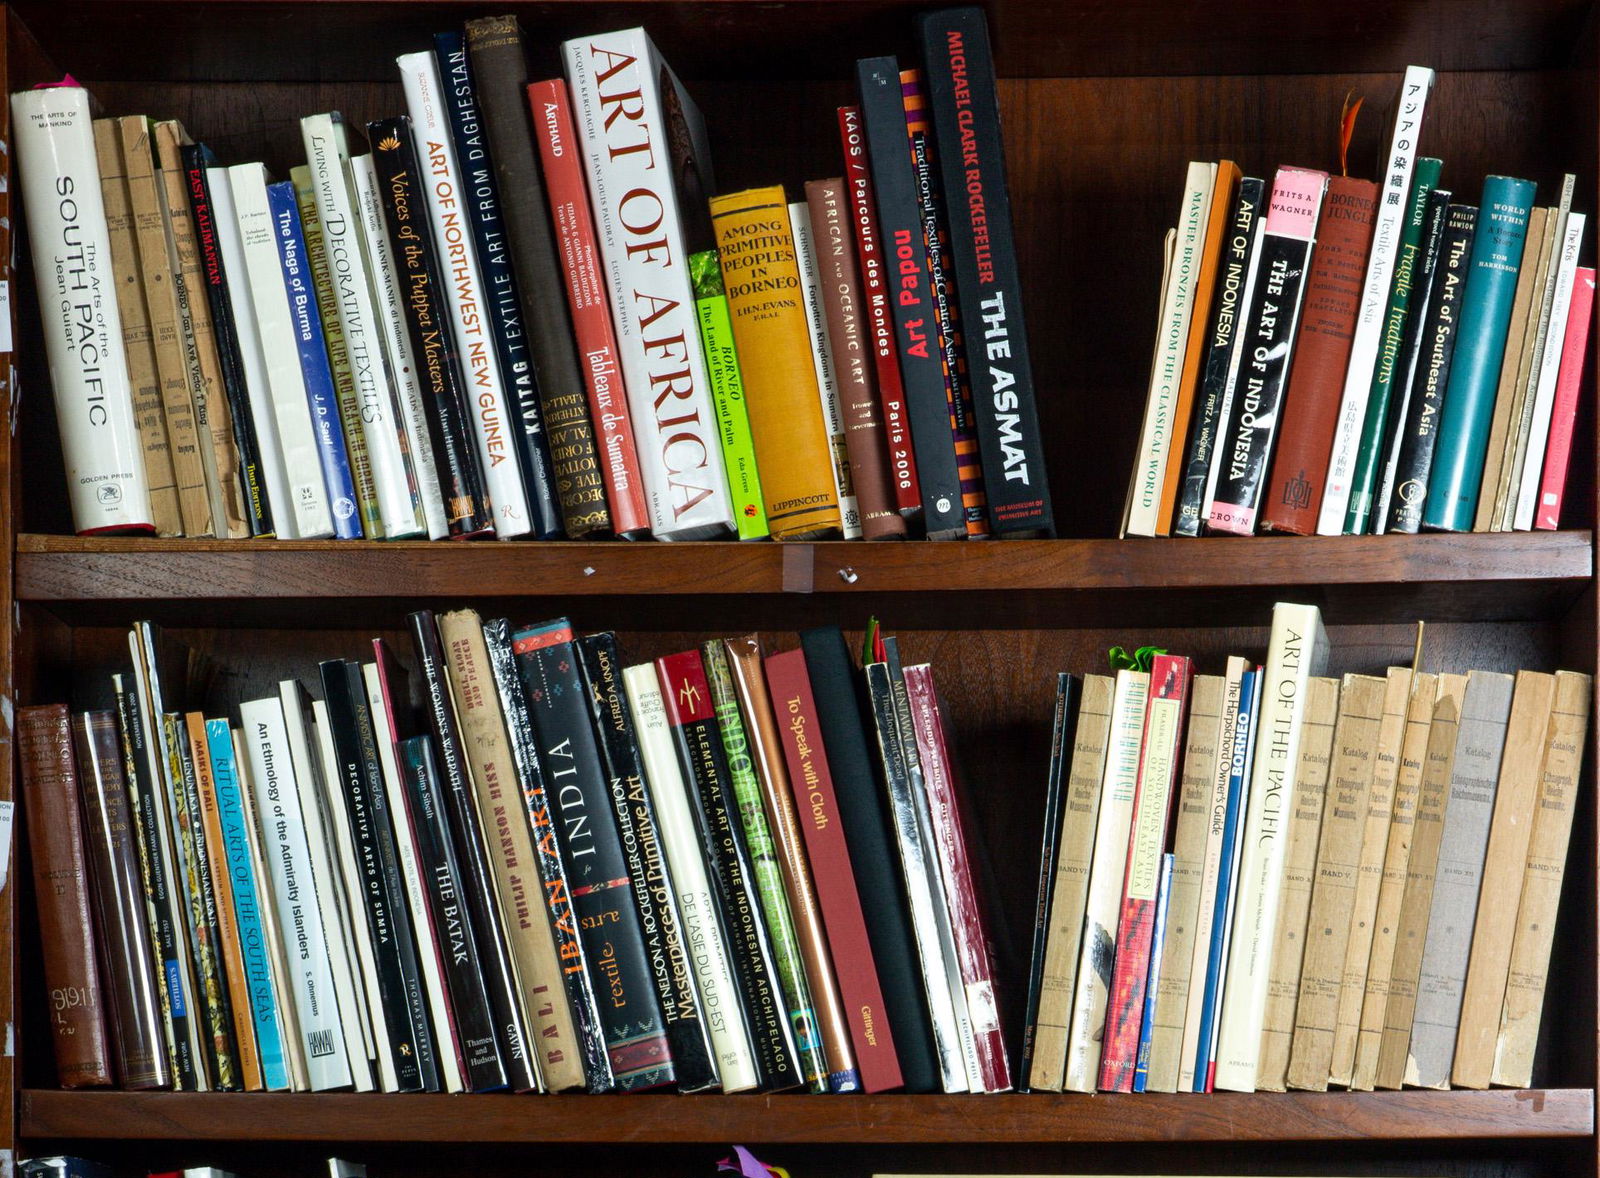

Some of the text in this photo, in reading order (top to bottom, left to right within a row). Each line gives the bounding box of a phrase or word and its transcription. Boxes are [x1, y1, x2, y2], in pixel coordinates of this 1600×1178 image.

[38, 120, 73, 130] MANKIND
[544, 103, 562, 157] ARTHAUD
[845, 112, 862, 157] KAOS
[1387, 84, 1420, 206] アジアの染織展
[189, 170, 220, 285] EAST KALIMANTAN
[723, 220, 782, 240] AMONG
[855, 179, 874, 253] Parcours
[1271, 203, 1312, 216] WAGNER
[1274, 189, 1303, 201] FRITS
[1491, 213, 1524, 225] WITHIN
[1494, 203, 1526, 215] WORLD
[279, 210, 311, 341] The Naga of Burma
[591, 42, 713, 523] ART OF AFRICA
[718, 234, 791, 258] PRIMITIVE
[723, 250, 793, 272] PEOPLES
[729, 276, 797, 299] BORNEO
[751, 267, 767, 278] IN
[866, 259, 879, 289] des
[947, 31, 1029, 486] MICHAEL CLARK ROCKEFELLER THE ASMAT
[53, 257, 76, 351] Jean Guiart
[56, 176, 107, 427] SOUTH PACIFIC
[87, 242, 108, 358] The Arts of the
[426, 142, 506, 468] ART OF NORTHWEST NEW GUINEA
[872, 294, 889, 358] Mondes
[895, 230, 928, 359] Art Papou
[1230, 260, 1287, 481] THE ART OF INDONESIA
[1419, 239, 1466, 436] The Art of Southeast Asia
[889, 401, 901, 444] Paris
[895, 447, 910, 489] 2006
[1232, 713, 1248, 776] BORNEO
[1260, 628, 1302, 848] ART OF THE PACIFIC
[549, 737, 596, 859] INDIA
[257, 723, 309, 959] An Ethnology of the Admiralty Islanders
[787, 696, 878, 1047] To Speak with Cloth Gittinger
[435, 862, 469, 965] THE BATAK
[629, 775, 696, 1019] Masterpieces of Primitive Art
